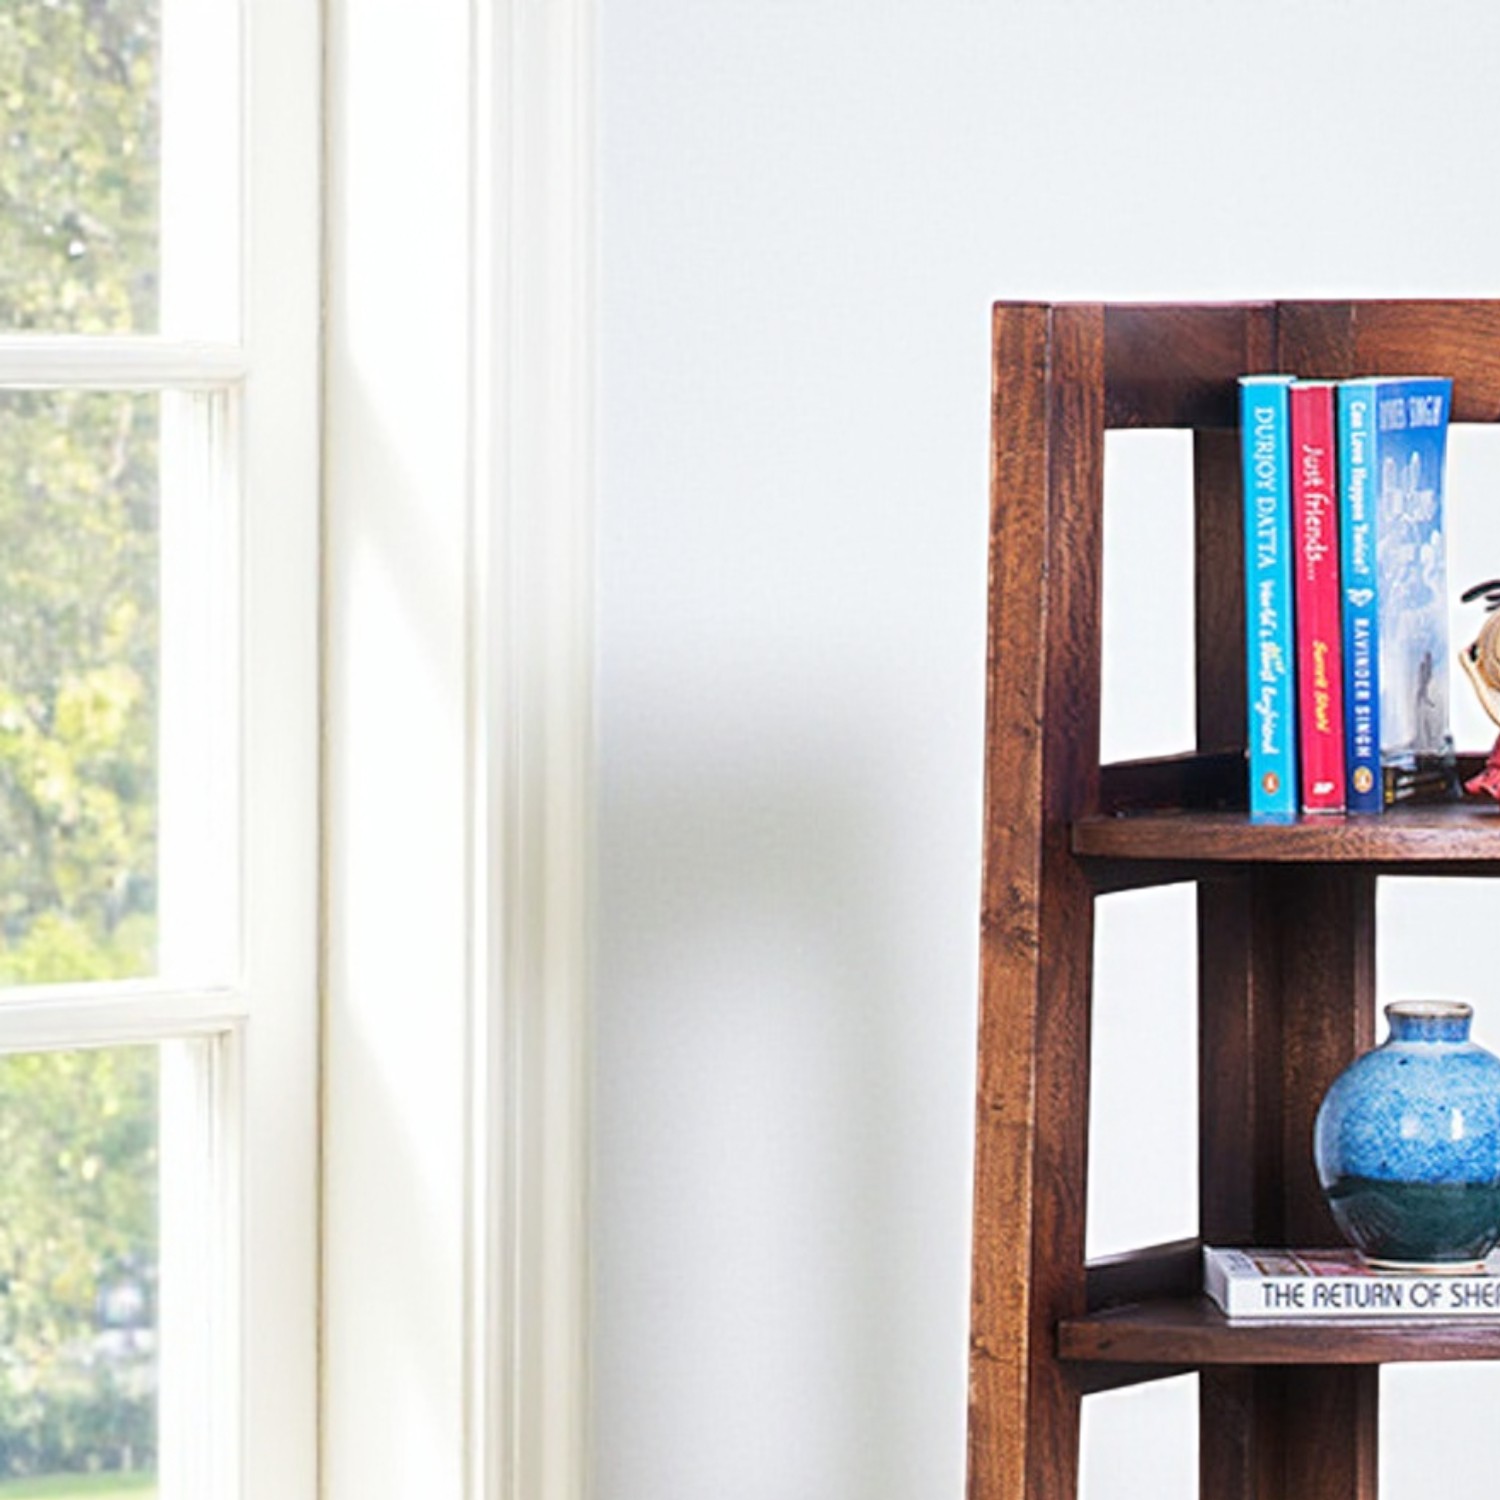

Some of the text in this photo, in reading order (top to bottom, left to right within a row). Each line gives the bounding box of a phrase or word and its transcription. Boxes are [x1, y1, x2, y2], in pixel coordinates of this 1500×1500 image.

[1254, 406, 1277, 491] DURJOY
[1302, 444, 1325, 487] Just
[1350, 430, 1368, 465] Love
[1256, 496, 1277, 569] DATTA
[1354, 618, 1372, 758] RAVINDER SINGH
[1261, 1283, 1305, 1309] THE
[1312, 1283, 1403, 1309] RETURN
[1409, 1283, 1442, 1309] OF
